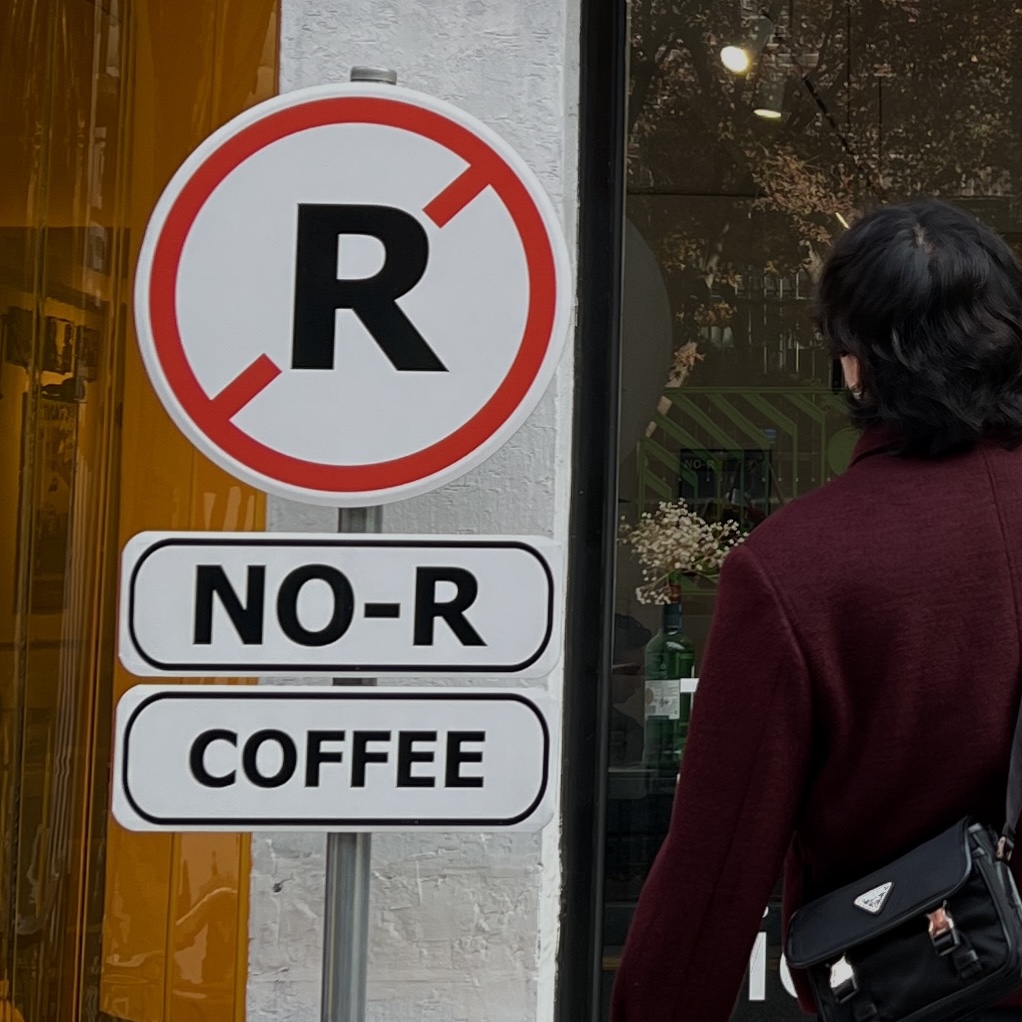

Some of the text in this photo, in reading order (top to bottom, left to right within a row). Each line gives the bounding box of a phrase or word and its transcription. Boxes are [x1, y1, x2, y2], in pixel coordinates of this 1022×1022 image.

[291, 202, 449, 371] R
[192, 563, 487, 647] NO-R
[188, 728, 486, 789] COFFEE
